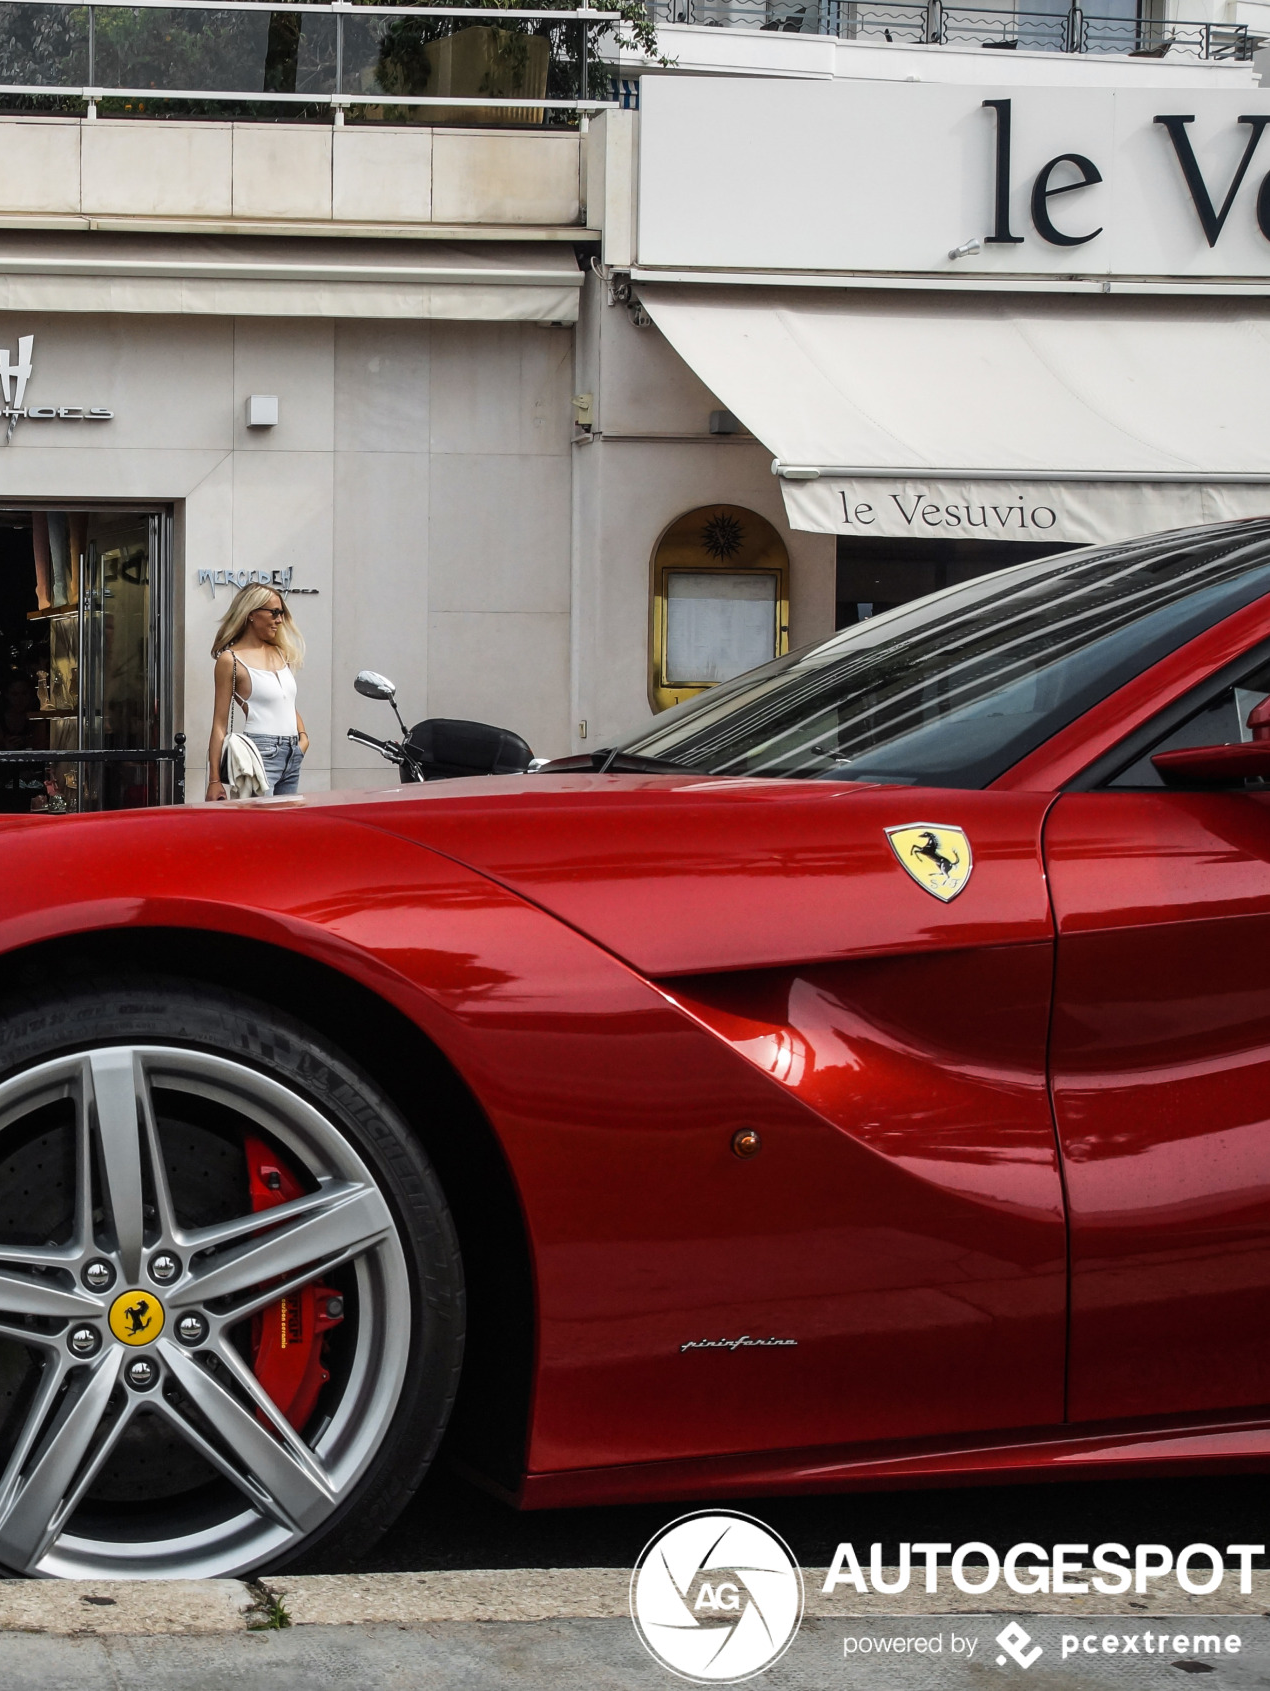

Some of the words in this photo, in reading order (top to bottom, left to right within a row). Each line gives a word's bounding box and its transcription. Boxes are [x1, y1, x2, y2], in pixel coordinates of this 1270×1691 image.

[982, 98, 1104, 248] le
[1153, 115, 1270, 248] V
[838, 490, 876, 525] le
[888, 493, 1057, 529] Vesuvio
[197, 566, 292, 600] MERCEDEH
[681, 1336, 798, 1352] pininfarina
